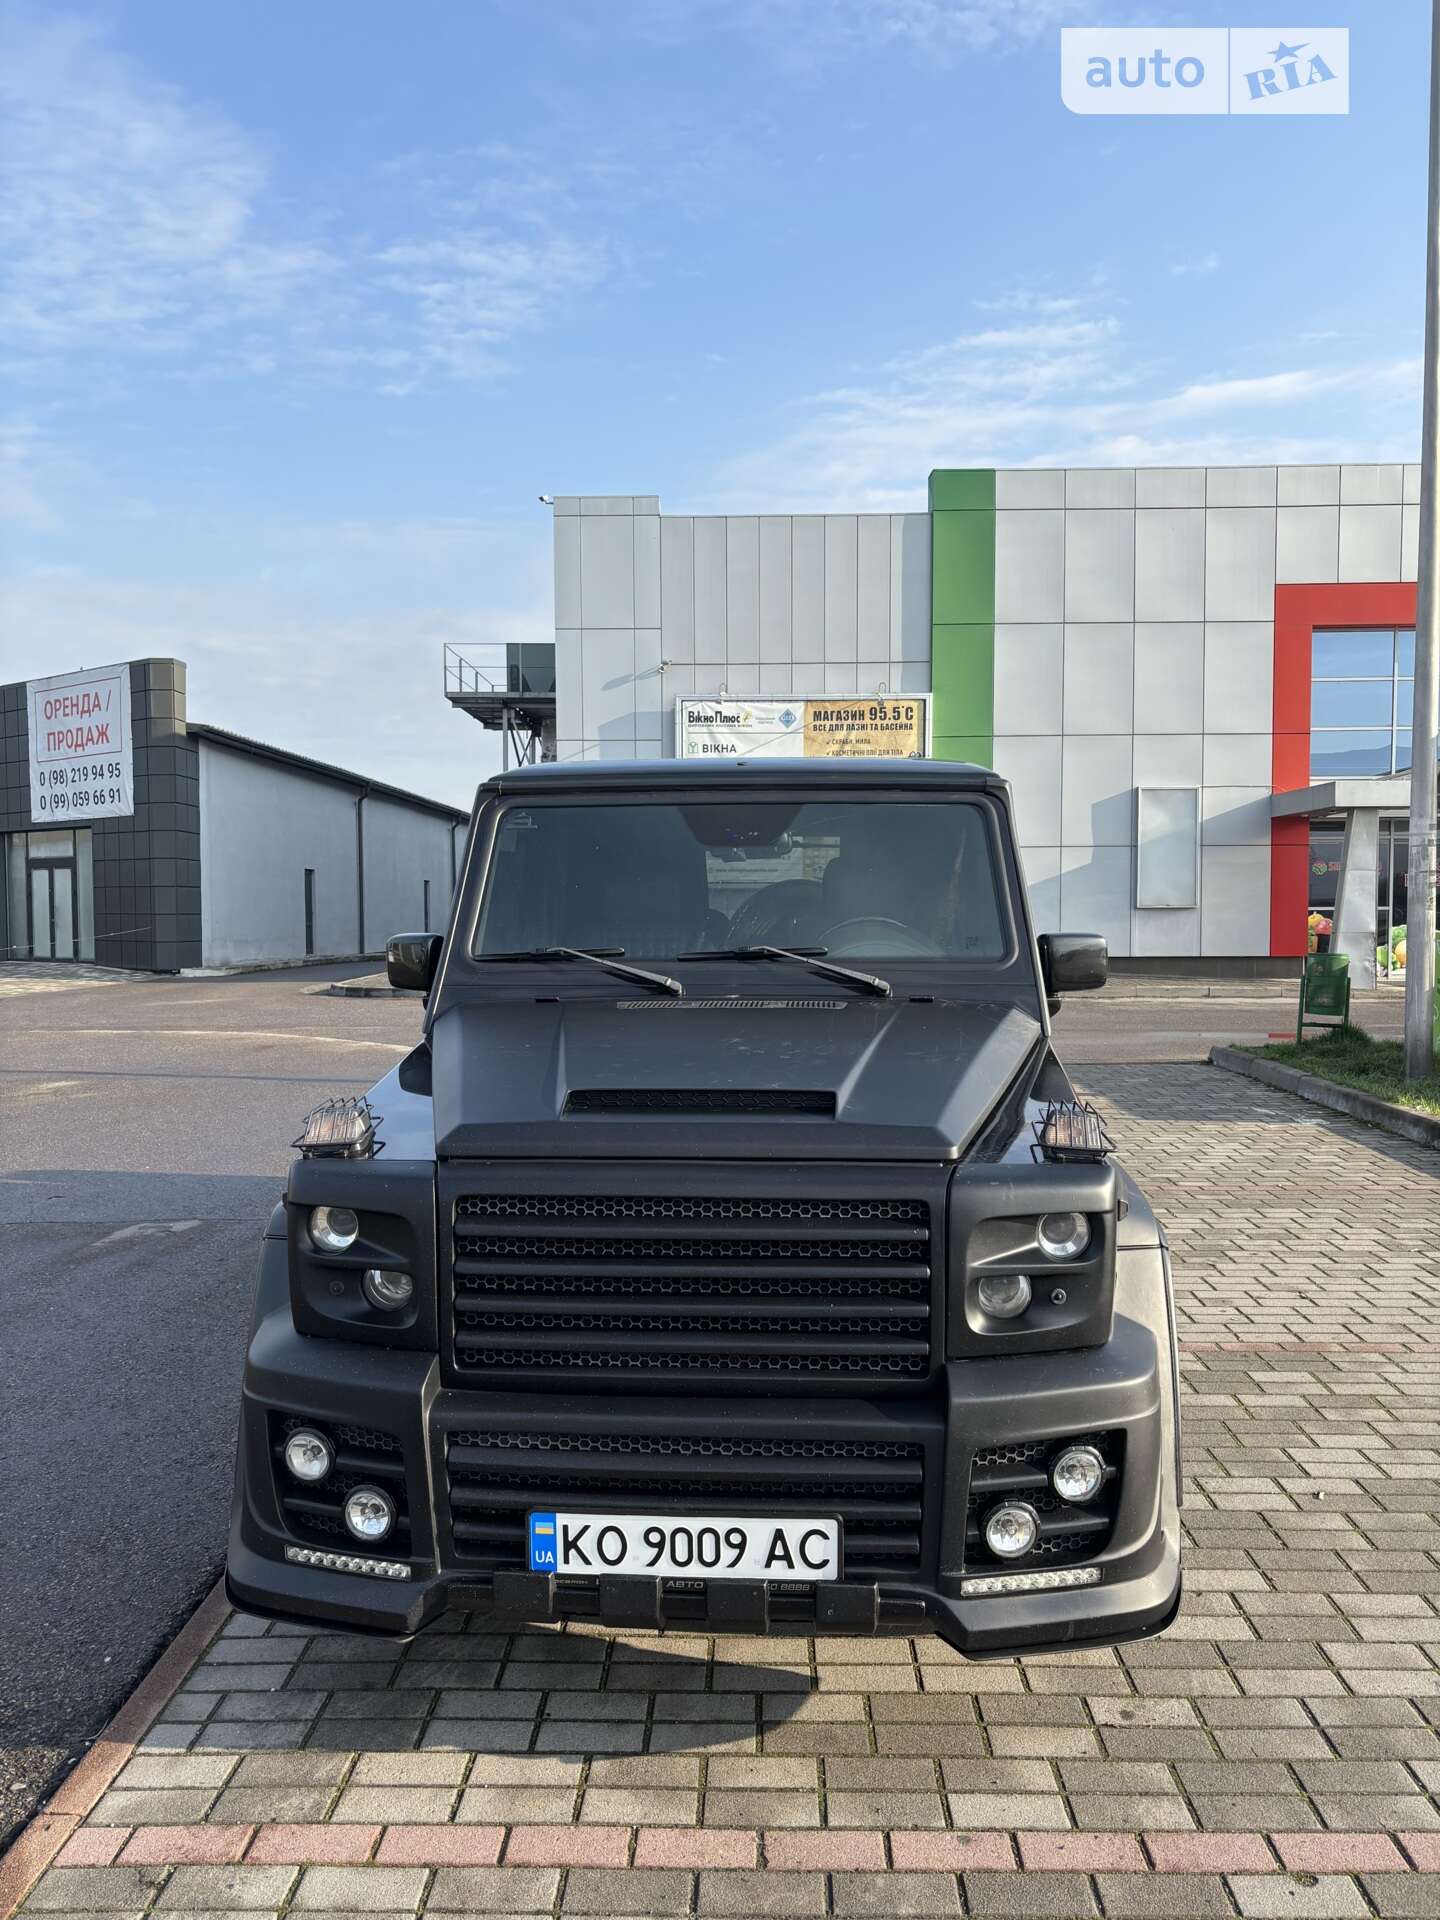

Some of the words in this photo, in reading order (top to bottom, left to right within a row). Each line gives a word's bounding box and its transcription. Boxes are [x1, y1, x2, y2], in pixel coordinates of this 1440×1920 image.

[44, 691, 101, 720] ОРЕНДА
[813, 710, 865, 721] МАГАЗИН
[47, 723, 110, 752] ПРОДАЖ
[813, 724, 826, 732] ВСЕ
[828, 724, 844, 732] ДЛЯ
[880, 722, 913, 731] БАСЕЙНА
[702, 744, 737, 753] ВІКНА
[40, 771, 45, 786] 0
[49, 768, 68, 789] (98)
[71, 766, 88, 783] 219
[91, 764, 104, 780] 94
[107, 762, 121, 778] 95
[40, 795, 46, 810] 0
[50, 791, 69, 813] (99)
[72, 790, 90, 807] 059
[93, 789, 106, 805] 66
[109, 788, 121, 804] 91
[535, 1551, 554, 1563] UA
[562, 1524, 628, 1566] KO
[643, 1526, 748, 1568] 9009
[764, 1528, 830, 1570] AC
